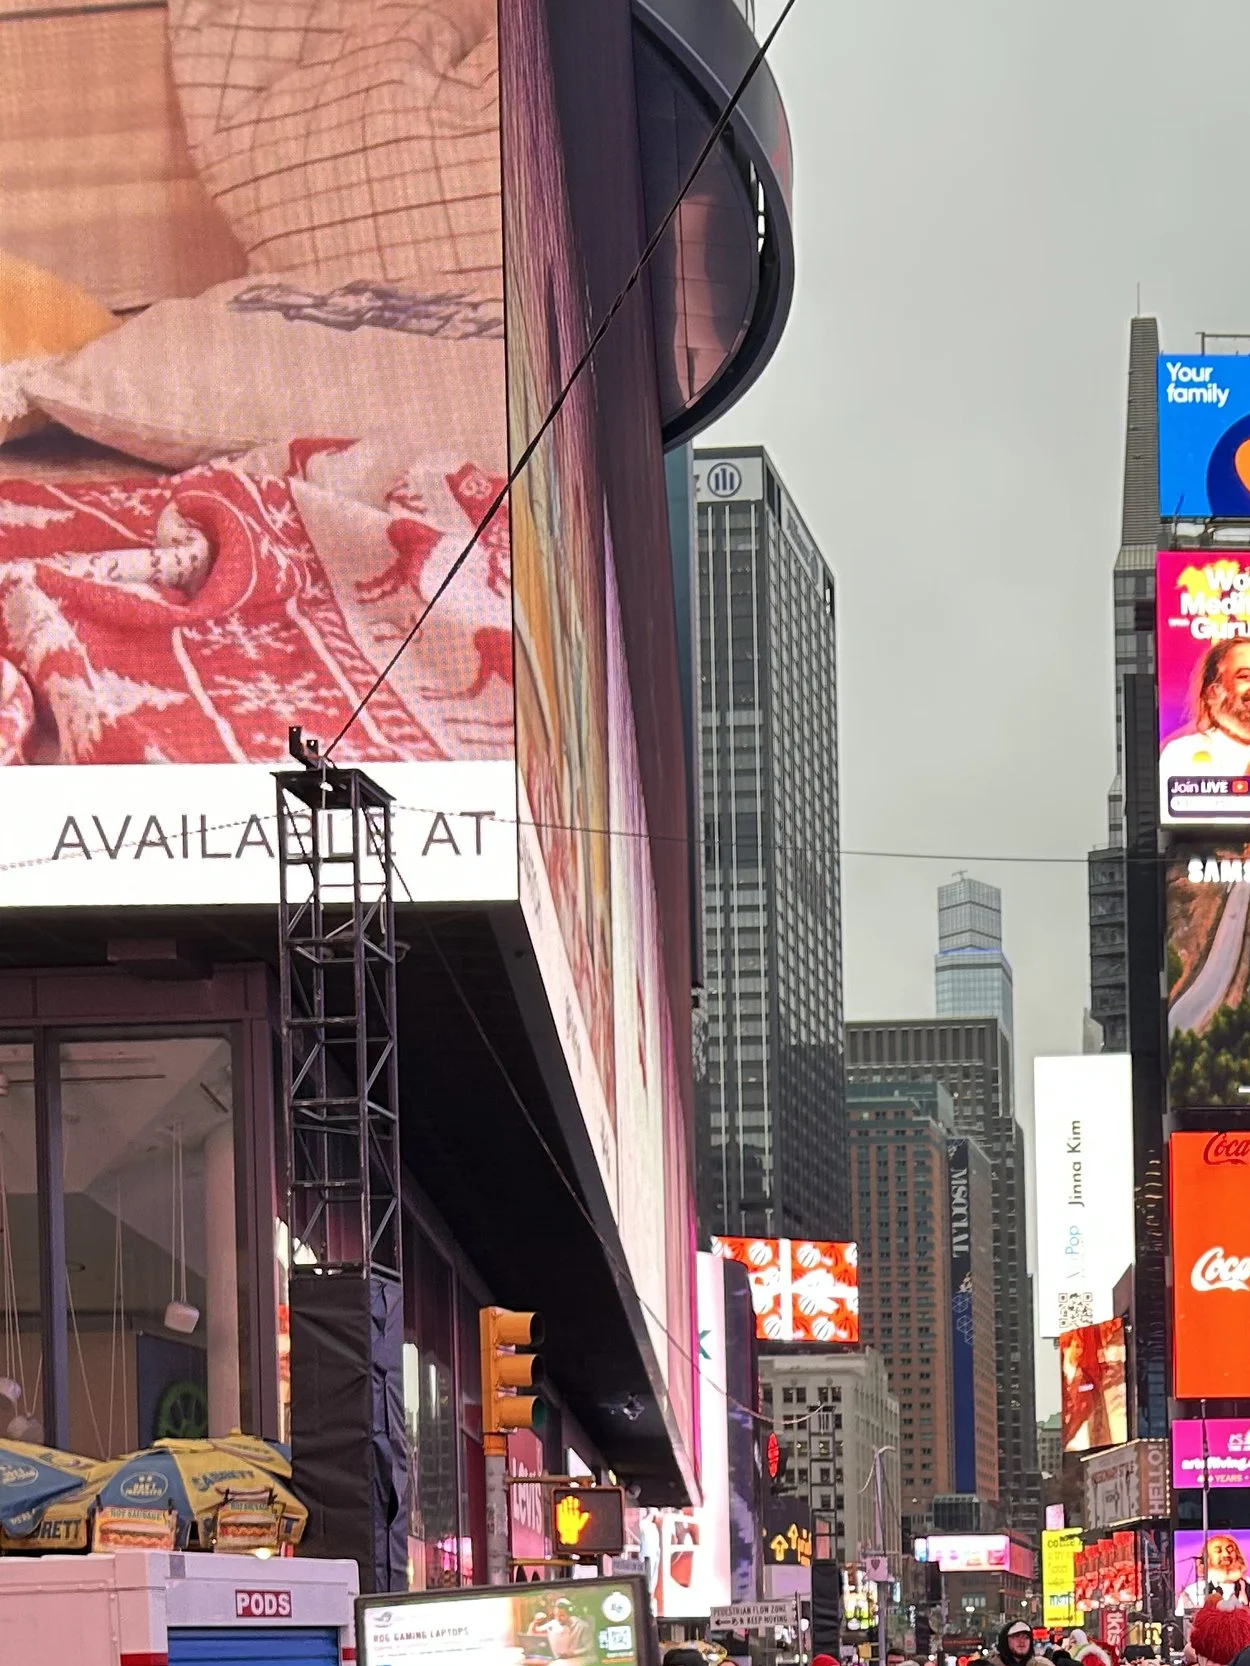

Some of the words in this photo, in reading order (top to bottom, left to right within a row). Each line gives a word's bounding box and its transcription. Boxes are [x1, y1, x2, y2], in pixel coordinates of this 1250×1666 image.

[1166, 362, 1213, 383] Your
[1166, 383, 1230, 408] family
[1171, 780, 1199, 794] Join
[1200, 780, 1228, 793] LIVE
[52, 813, 396, 860] AVAILABLE
[422, 810, 495, 857] AT
[1067, 1120, 1081, 1154] Kim
[1068, 1161, 1085, 1207] Jinna
[1148, 1444, 1165, 1515] HELLO!
[1215, 1474, 1243, 1482] YEARS
[237, 1591, 291, 1617] PODS
[713, 1607, 751, 1617] PEDESTRIAN
[752, 1606, 769, 1614] FLOW
[771, 1605, 787, 1613] ZONE
[747, 1617, 762, 1625] KEEP
[764, 1616, 787, 1624] MOVING
[394, 1630, 428, 1642] GAMING
[430, 1627, 469, 1638] LAPTOPS
